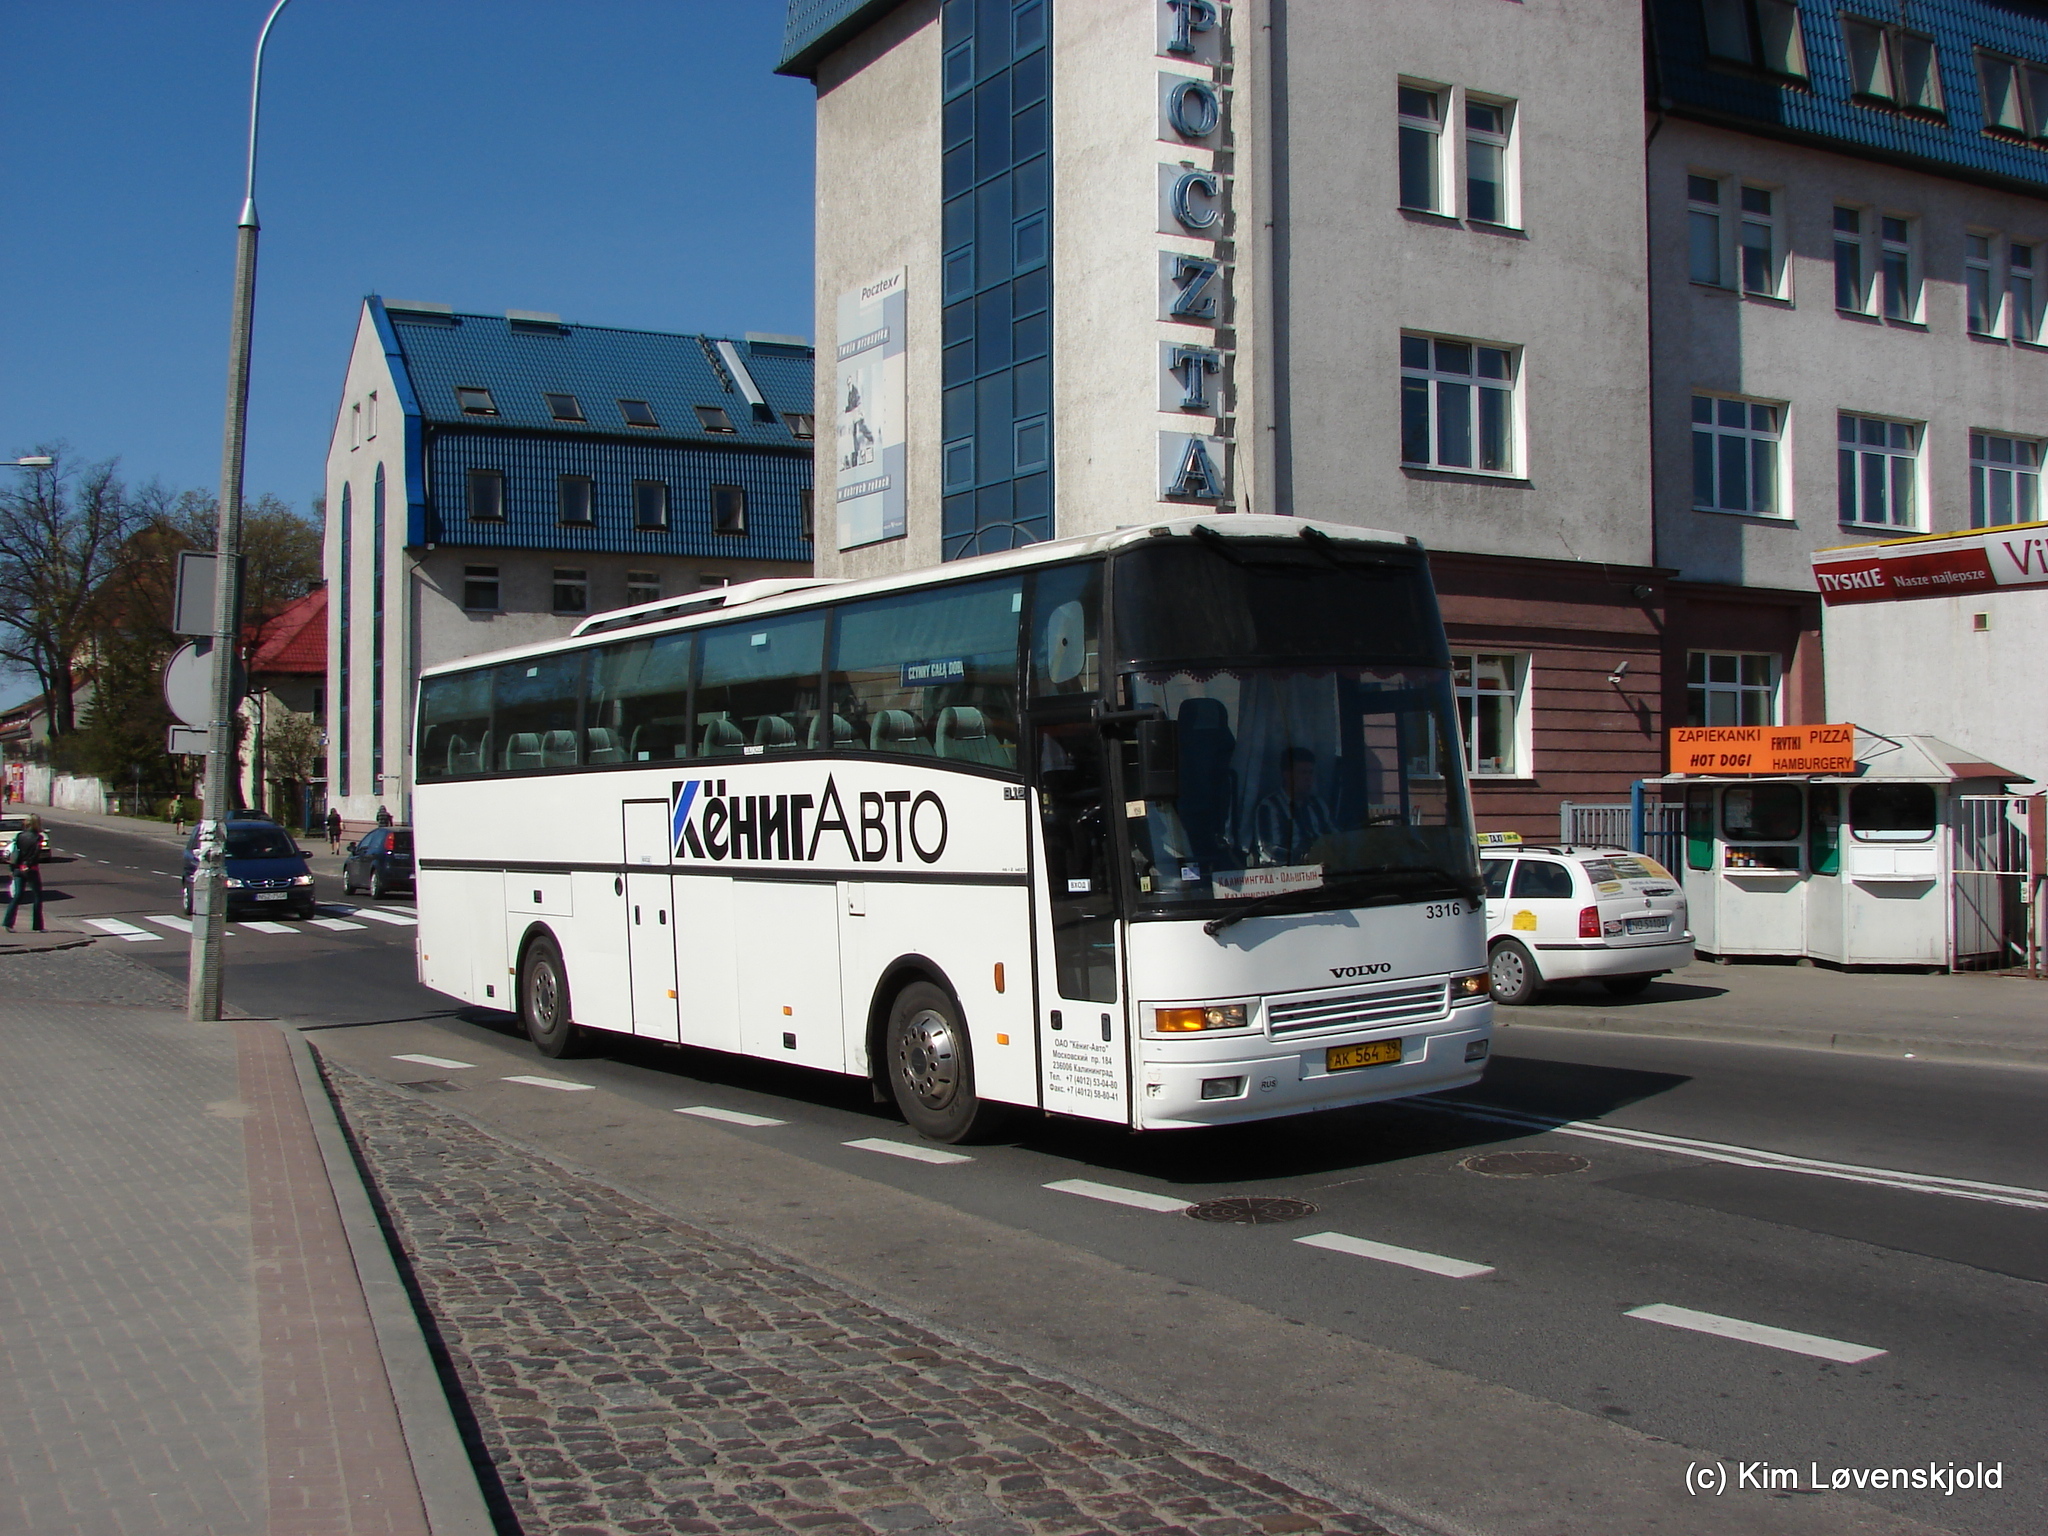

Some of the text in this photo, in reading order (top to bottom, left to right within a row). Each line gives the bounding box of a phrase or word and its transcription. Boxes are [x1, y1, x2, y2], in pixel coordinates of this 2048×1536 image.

[1165, 0, 1224, 499] POCZTA
[861, 276, 895, 301] Pocztex
[2002, 539, 2048, 576] Vi
[1818, 568, 1986, 592] TYSKIE Nasze najlepsze
[1678, 729, 1851, 744] ZAPIEKANKI PIZZA
[1771, 737, 1802, 751] FRYTKI
[1690, 754, 1752, 767] HOT DOGI
[1772, 757, 1852, 770] HAMBURGERY
[1489, 834, 1503, 844] TAXI
[1217, 874, 1275, 888] КАЛИНИНГРАД
[1280, 871, 1318, 883] ОЛЬШТЫН
[1426, 902, 1460, 919] 3316
[1329, 962, 1391, 979] VOLVO
[1054, 1038, 1068, 1048] ОАО
[1052, 1050, 1088, 1061] Московский
[1101, 1056, 1112, 1065] 184
[1355, 1046, 1379, 1063] 564
[1385, 1041, 1397, 1054] 39
[1073, 1064, 1114, 1078] Калининград
[1049, 1071, 1061, 1081] Тел.
[1066, 1074, 1073, 1082] +7
[1074, 1075, 1092, 1087] (4012)
[1261, 1079, 1276, 1089] RUS
[1067, 1086, 1074, 1094] +7
[1075, 1087, 1092, 1099] (4012)
